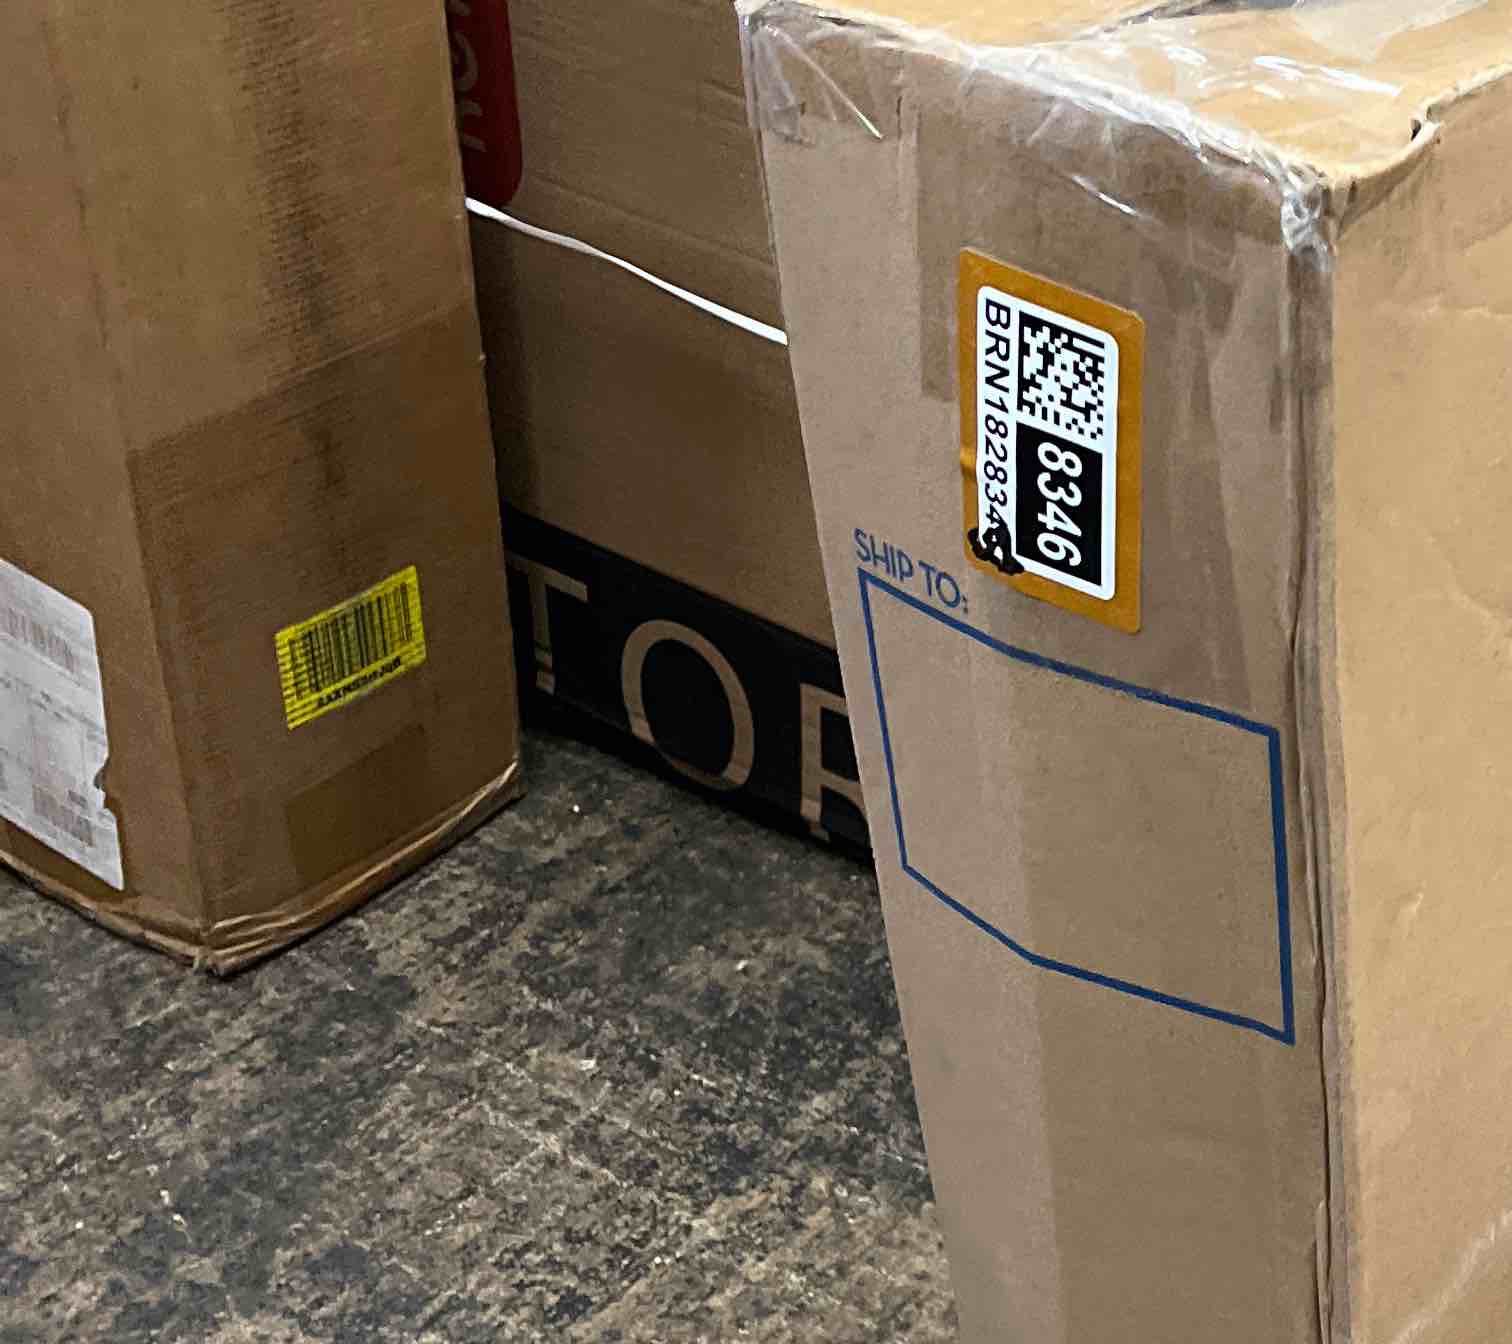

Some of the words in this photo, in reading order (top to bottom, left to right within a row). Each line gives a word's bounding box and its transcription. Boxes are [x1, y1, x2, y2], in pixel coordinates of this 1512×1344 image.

[985, 297, 1011, 554] BRN182834
[1037, 441, 1083, 567] 8346
[855, 528, 913, 582] SHIP
[918, 560, 969, 614] TO:
